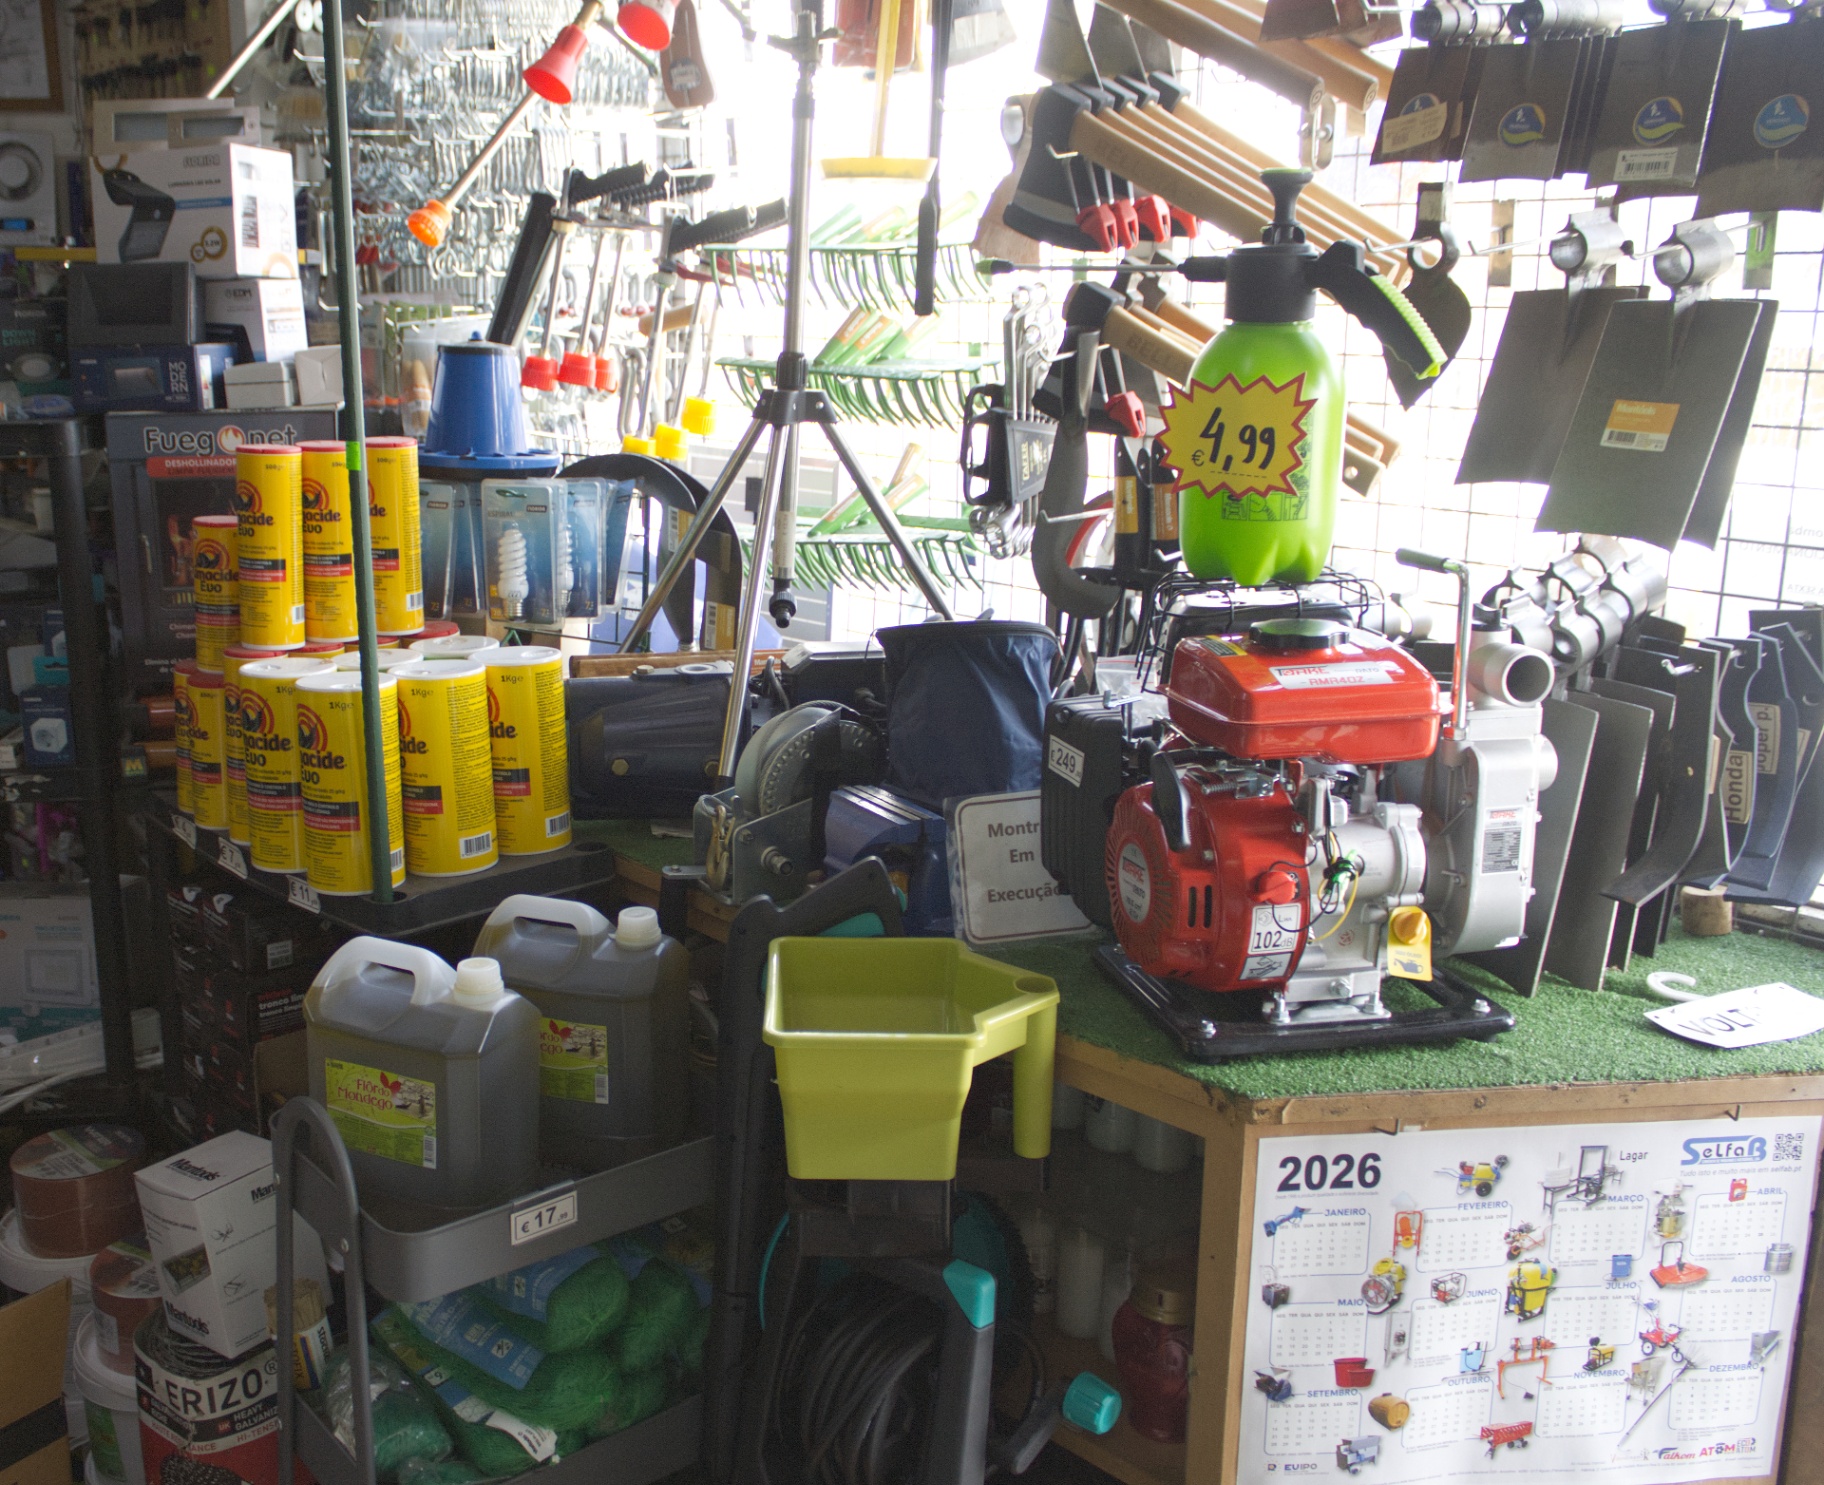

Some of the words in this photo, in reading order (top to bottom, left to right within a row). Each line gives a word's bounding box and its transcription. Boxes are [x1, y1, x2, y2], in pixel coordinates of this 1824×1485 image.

[233, 288, 252, 298] EDM
[1199, 406, 1276, 471] 4,99
[1724, 754, 1742, 822] Honda
[987, 821, 1040, 838] Montr
[1010, 848, 1035, 864] Em
[258, 997, 290, 1011] tronco
[337, 1086, 394, 1111] Mondego
[1619, 1150, 1648, 1164] Lagar
[1277, 1152, 1382, 1192] 2026
[1680, 1169, 1697, 1178] Tudo
[1718, 1168, 1736, 1176] muito
[1737, 1167, 1757, 1176] mais
[1770, 1165, 1802, 1176] selfab.pt
[250, 1183, 275, 1202] Man
[1757, 1187, 1783, 1196] ABRIL
[1457, 1200, 1508, 1210] FEVEREIRO
[1608, 1194, 1644, 1205] MARÇO
[1324, 1208, 1367, 1217] JANEIRO
[522, 1221, 530, 1234] €
[1730, 1275, 1772, 1284] AGOSTO
[1605, 1282, 1637, 1290] JULHO
[1466, 1288, 1498, 1298] JUNHO
[1337, 1298, 1364, 1306] MAIO
[1709, 1362, 1760, 1373] DEZEMBRO
[1573, 1370, 1626, 1379] NOVEMBRO
[1448, 1376, 1491, 1387] OUTUBRO
[165, 1368, 263, 1418] ERIZO
[1307, 1389, 1358, 1398] SETEMBRO
[234, 1401, 264, 1422] HEAVY
[1284, 1463, 1318, 1471] EUIPO
